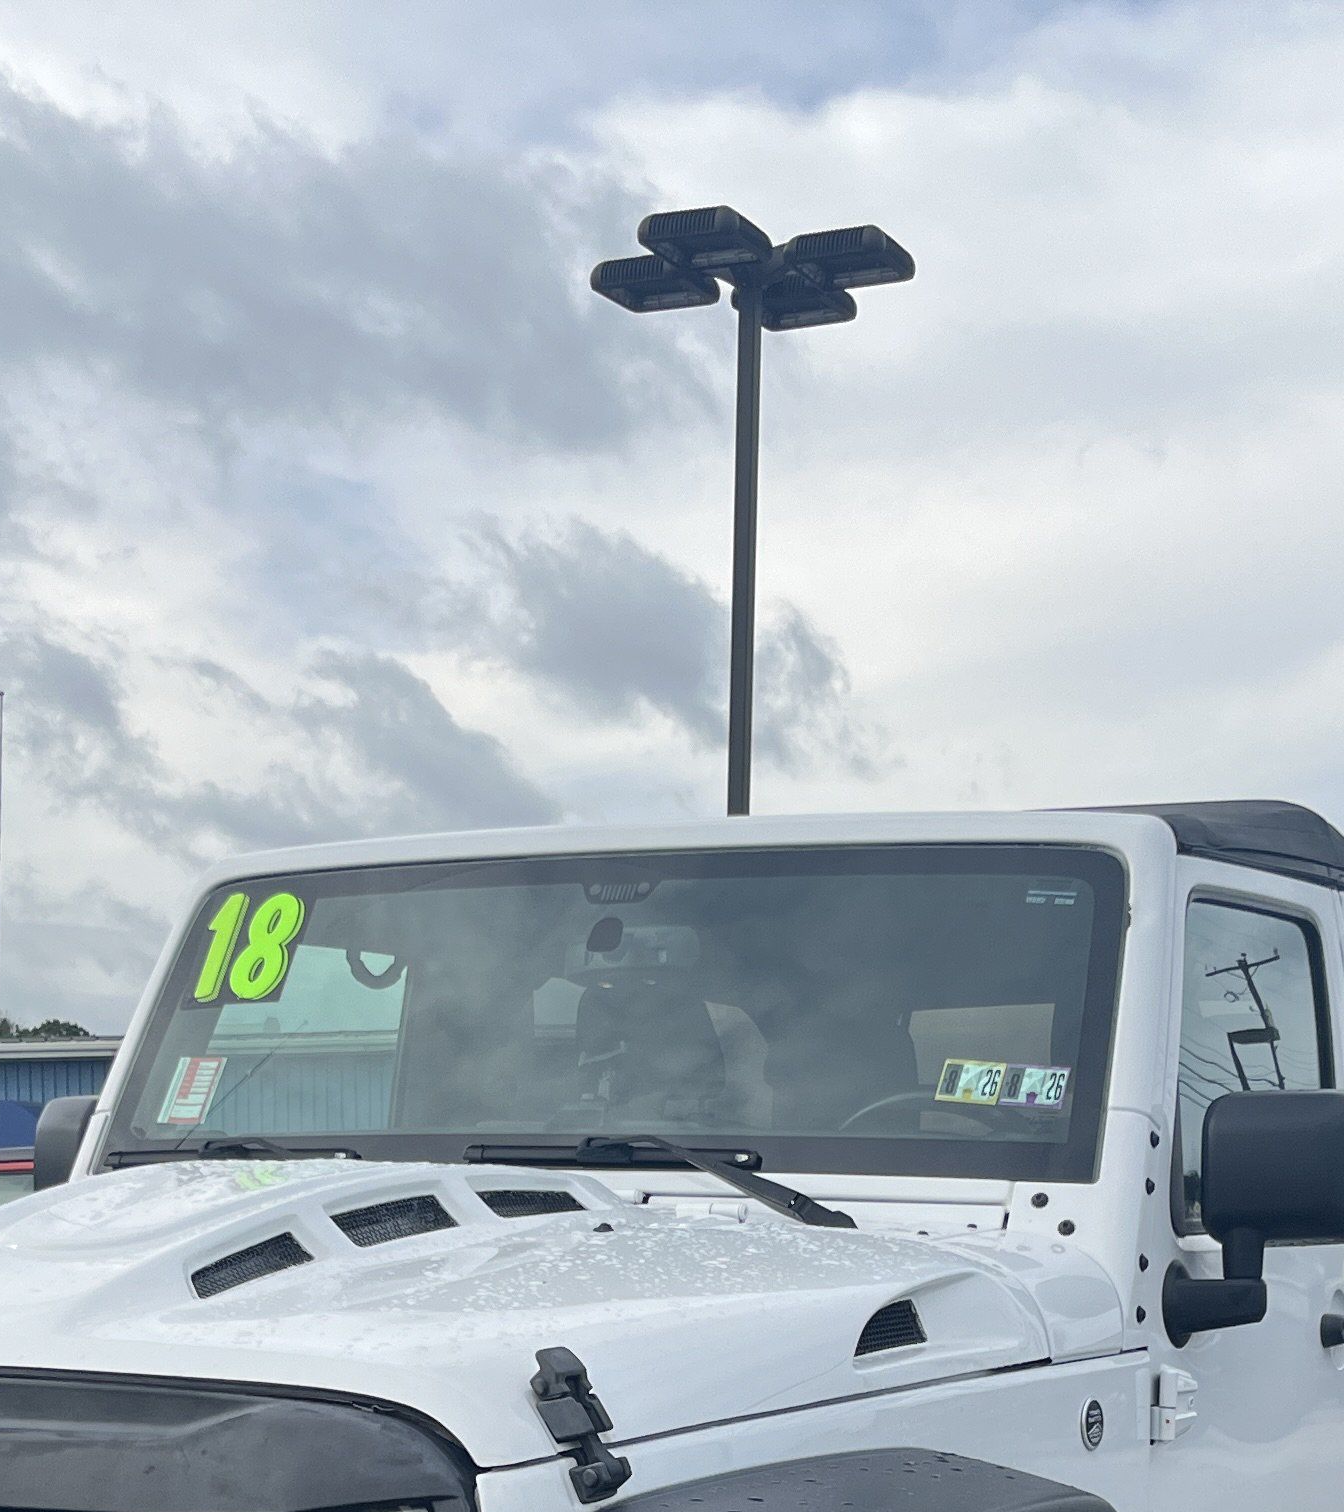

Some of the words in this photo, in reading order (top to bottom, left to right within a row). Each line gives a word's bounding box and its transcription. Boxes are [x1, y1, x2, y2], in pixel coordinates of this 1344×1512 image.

[194, 892, 305, 1003] 18
[945, 1069, 958, 1094] 8
[980, 1069, 1001, 1097] 26
[1007, 1073, 1020, 1098] 8
[1045, 1072, 1066, 1101] 26
